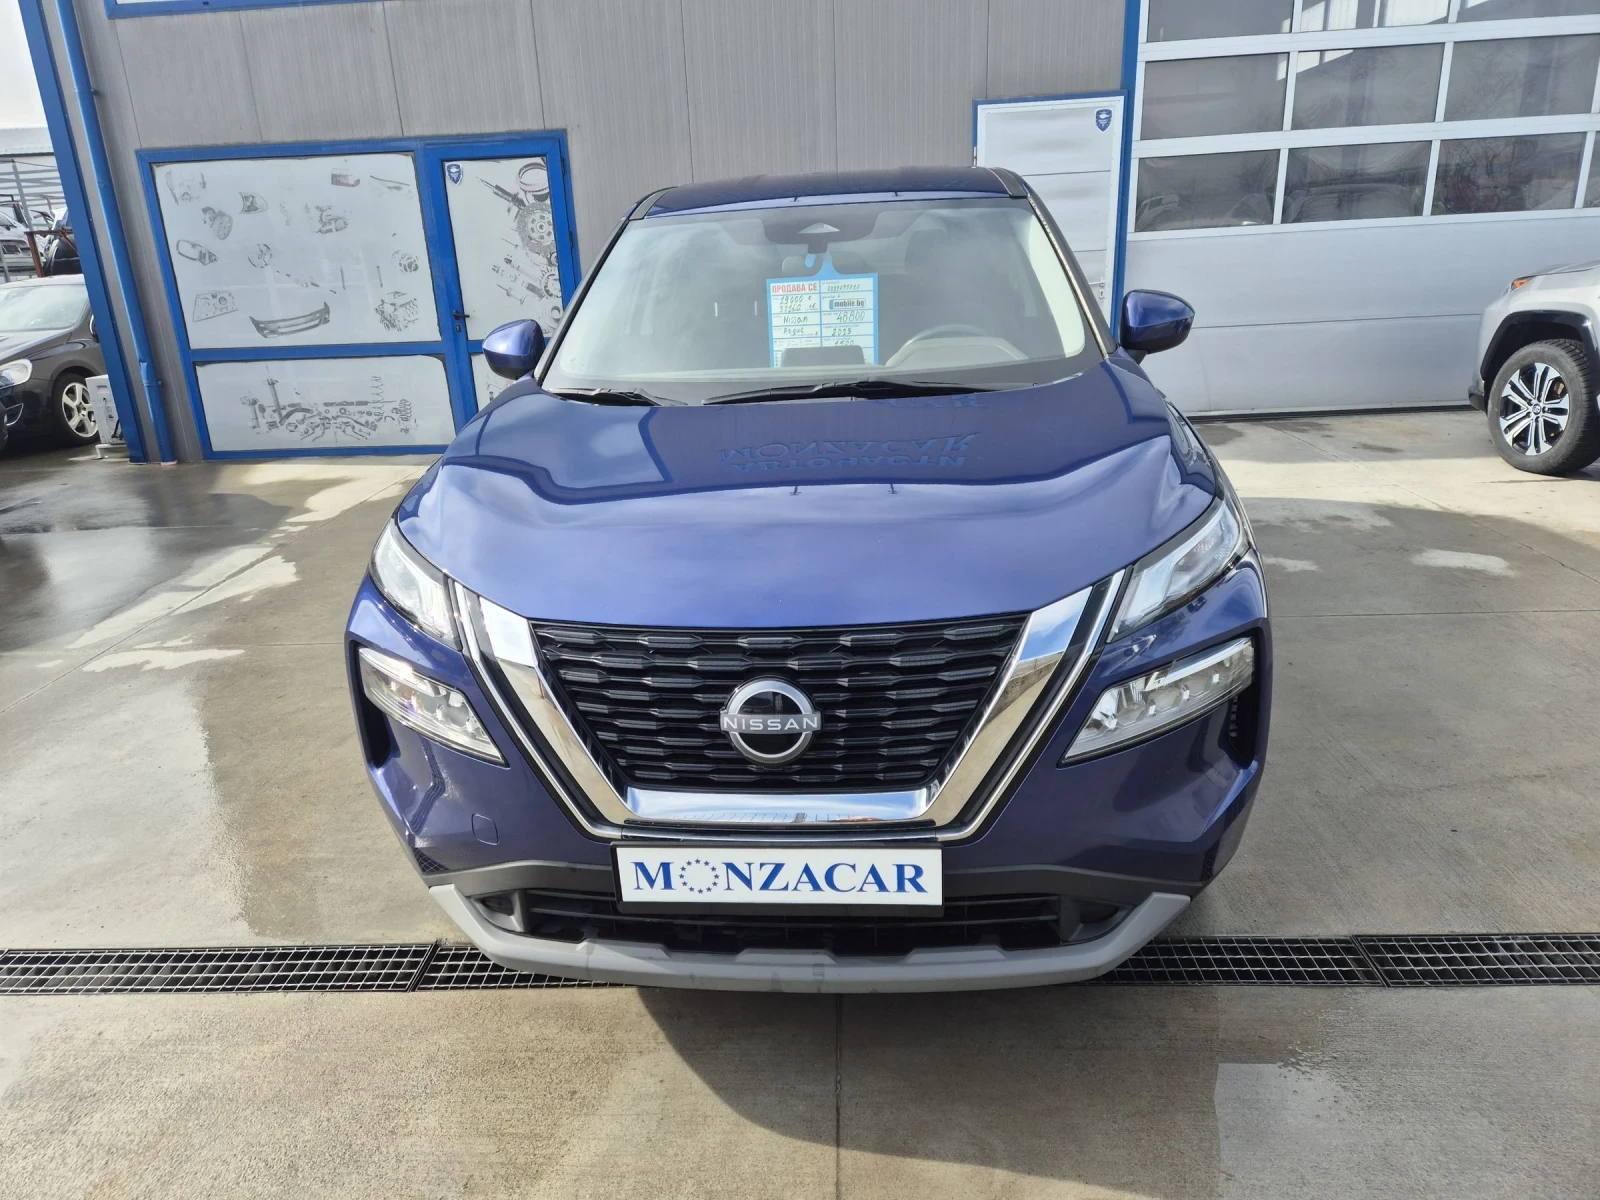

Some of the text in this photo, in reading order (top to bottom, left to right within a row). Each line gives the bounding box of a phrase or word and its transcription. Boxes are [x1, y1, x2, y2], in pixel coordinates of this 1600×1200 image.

[772, 282, 817, 293] ПРОДАВА СЕ
[834, 299, 865, 308] mobile.bg
[783, 315, 808, 324] Nissan
[836, 311, 865, 323] 48800
[832, 328, 851, 337] 2023
[723, 716, 819, 731] NISSAN
